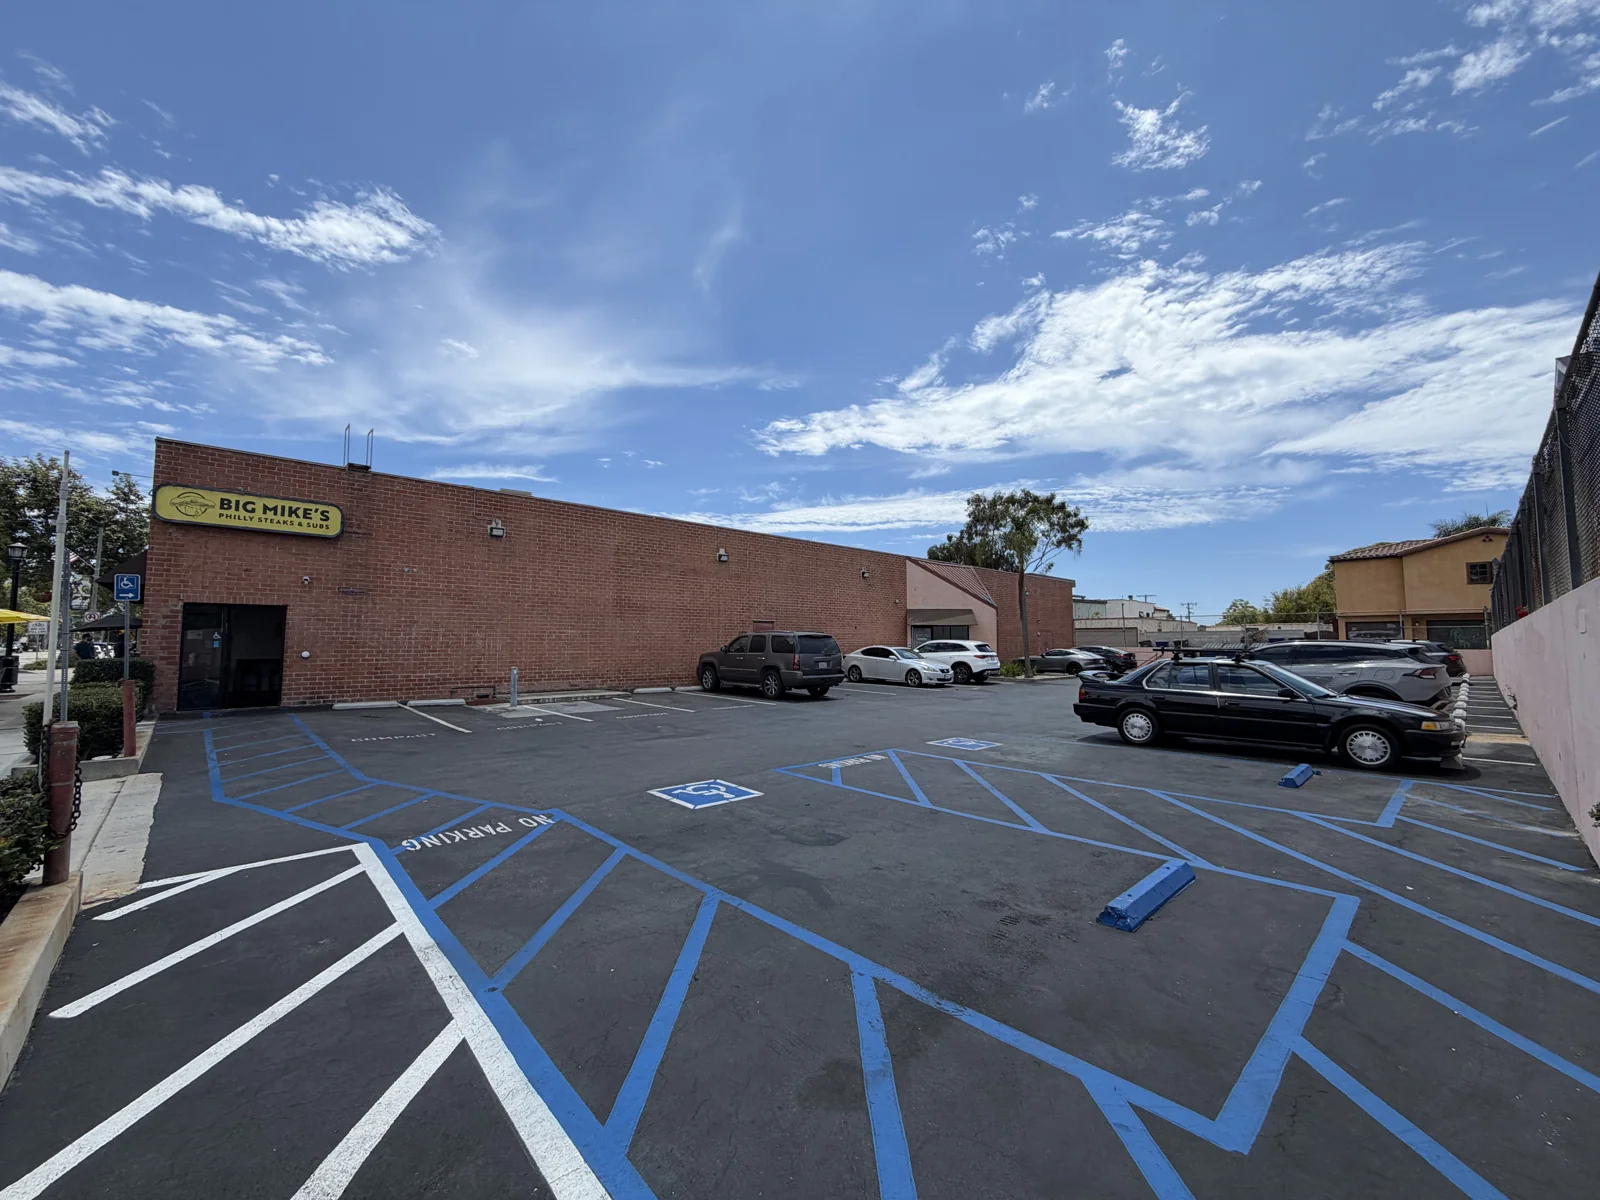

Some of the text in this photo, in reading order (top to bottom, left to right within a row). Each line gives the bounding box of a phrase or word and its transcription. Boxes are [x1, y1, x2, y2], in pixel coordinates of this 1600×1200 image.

[219, 498, 330, 521] BIG MIKE'S
[219, 513, 254, 521] PHILLY
[257, 517, 294, 526] STEAKS
[306, 522, 330, 530] SUBS
[401, 814, 555, 852] NO PARKING
